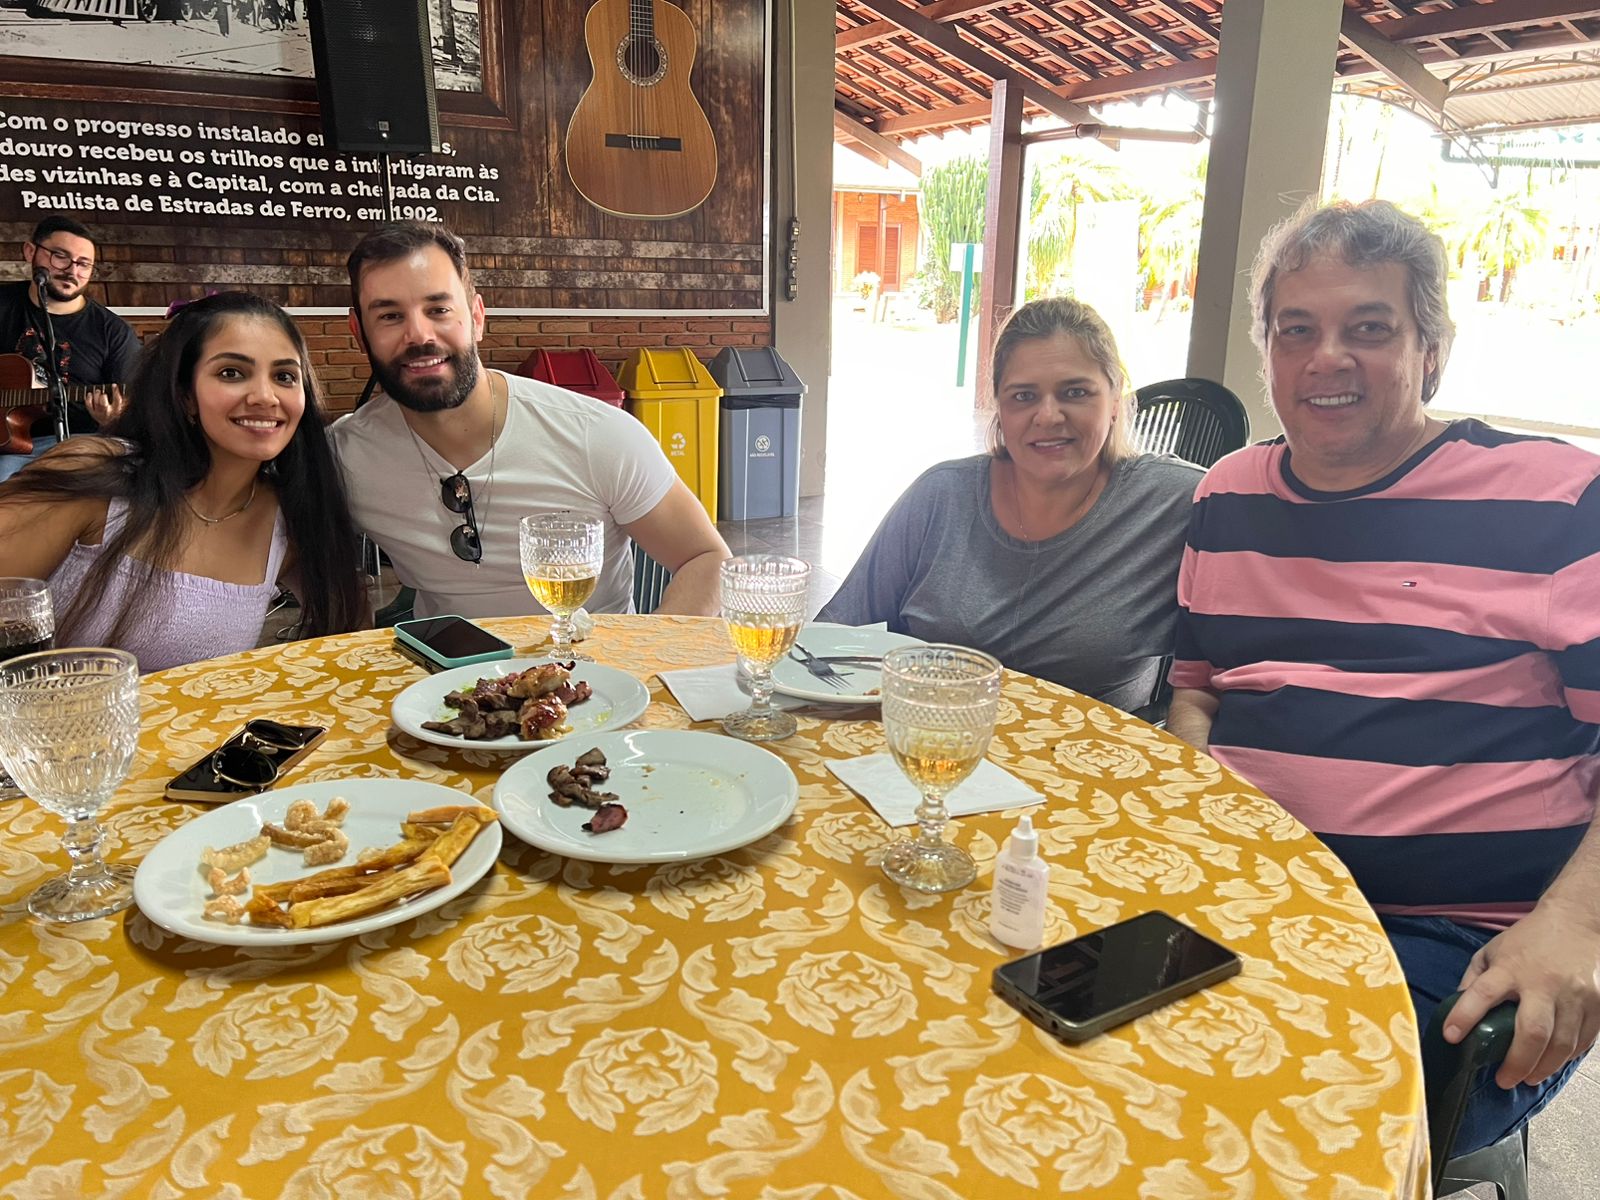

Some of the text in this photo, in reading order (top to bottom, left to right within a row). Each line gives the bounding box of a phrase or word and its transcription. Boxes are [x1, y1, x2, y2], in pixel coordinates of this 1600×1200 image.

[54, 118, 68, 131] o
[75, 119, 192, 138] progresso
[198, 122, 300, 144] instalado
[79, 144, 174, 162] recebeu
[180, 151, 205, 163] os
[211, 150, 283, 168] trilhos
[290, 157, 329, 173] que
[335, 160, 347, 171] a
[352, 157, 474, 180] intrligaram
[479, 164, 498, 179] às
[0, 164, 36, 182] des
[42, 166, 142, 186] vizinhas
[149, 174, 161, 186] e
[169, 171, 182, 187] à
[187, 172, 273, 194] Capital,
[280, 181, 325, 194] com
[331, 183, 342, 195] a
[436, 185, 459, 200] da
[464, 186, 499, 202] Cia.
[21, 191, 442, 222] Paulista de Estradas de Ferro, em 1902.
